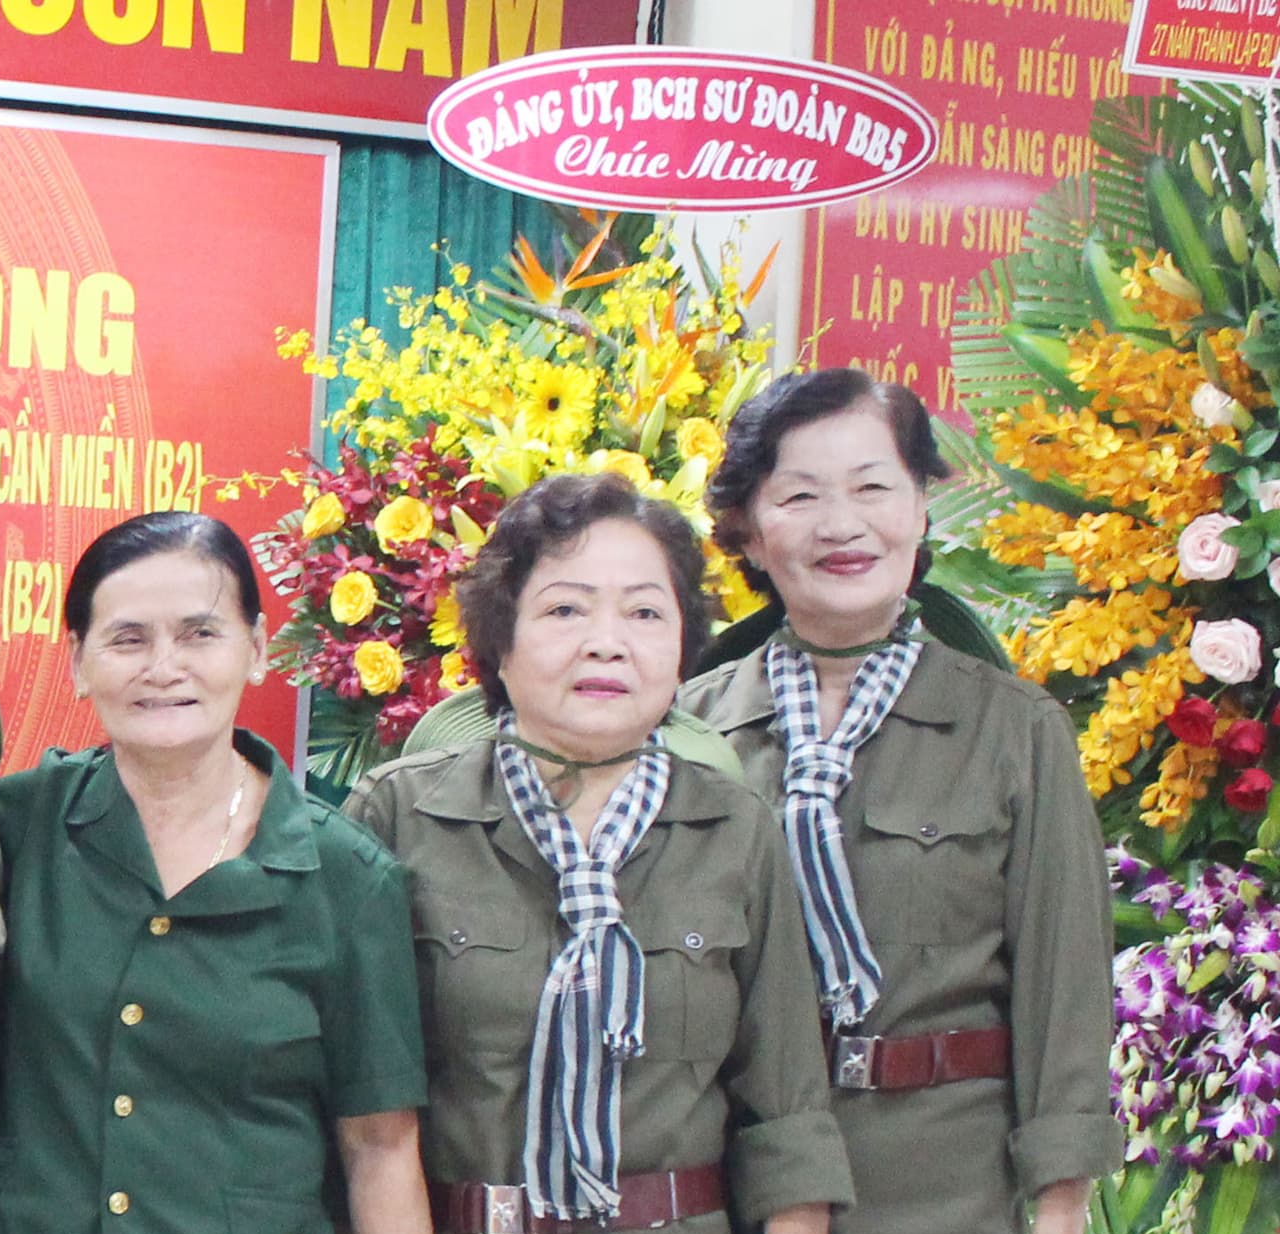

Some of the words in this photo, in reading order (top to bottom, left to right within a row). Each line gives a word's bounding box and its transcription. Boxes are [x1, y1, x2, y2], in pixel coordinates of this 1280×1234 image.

[865, 18, 907, 76] VỚI
[1017, 34, 1077, 99] HIẾU
[1149, 23, 1168, 56] 27
[468, 91, 563, 162] ĐẢNG
[570, 68, 624, 131] ỦY,
[631, 76, 695, 122] BCH
[701, 76, 748, 124] SƯ
[750, 84, 846, 147] ĐOÀN
[844, 112, 908, 174] BB5
[932, 100, 974, 167] ẴN
[981, 113, 1045, 178] SÀNG
[555, 133, 669, 180] Chúc
[676, 140, 819, 192] Mừng
[851, 263, 904, 332] LẬP
[60, 402, 134, 512] MIỀN
[2, 559, 65, 643] (B2)
